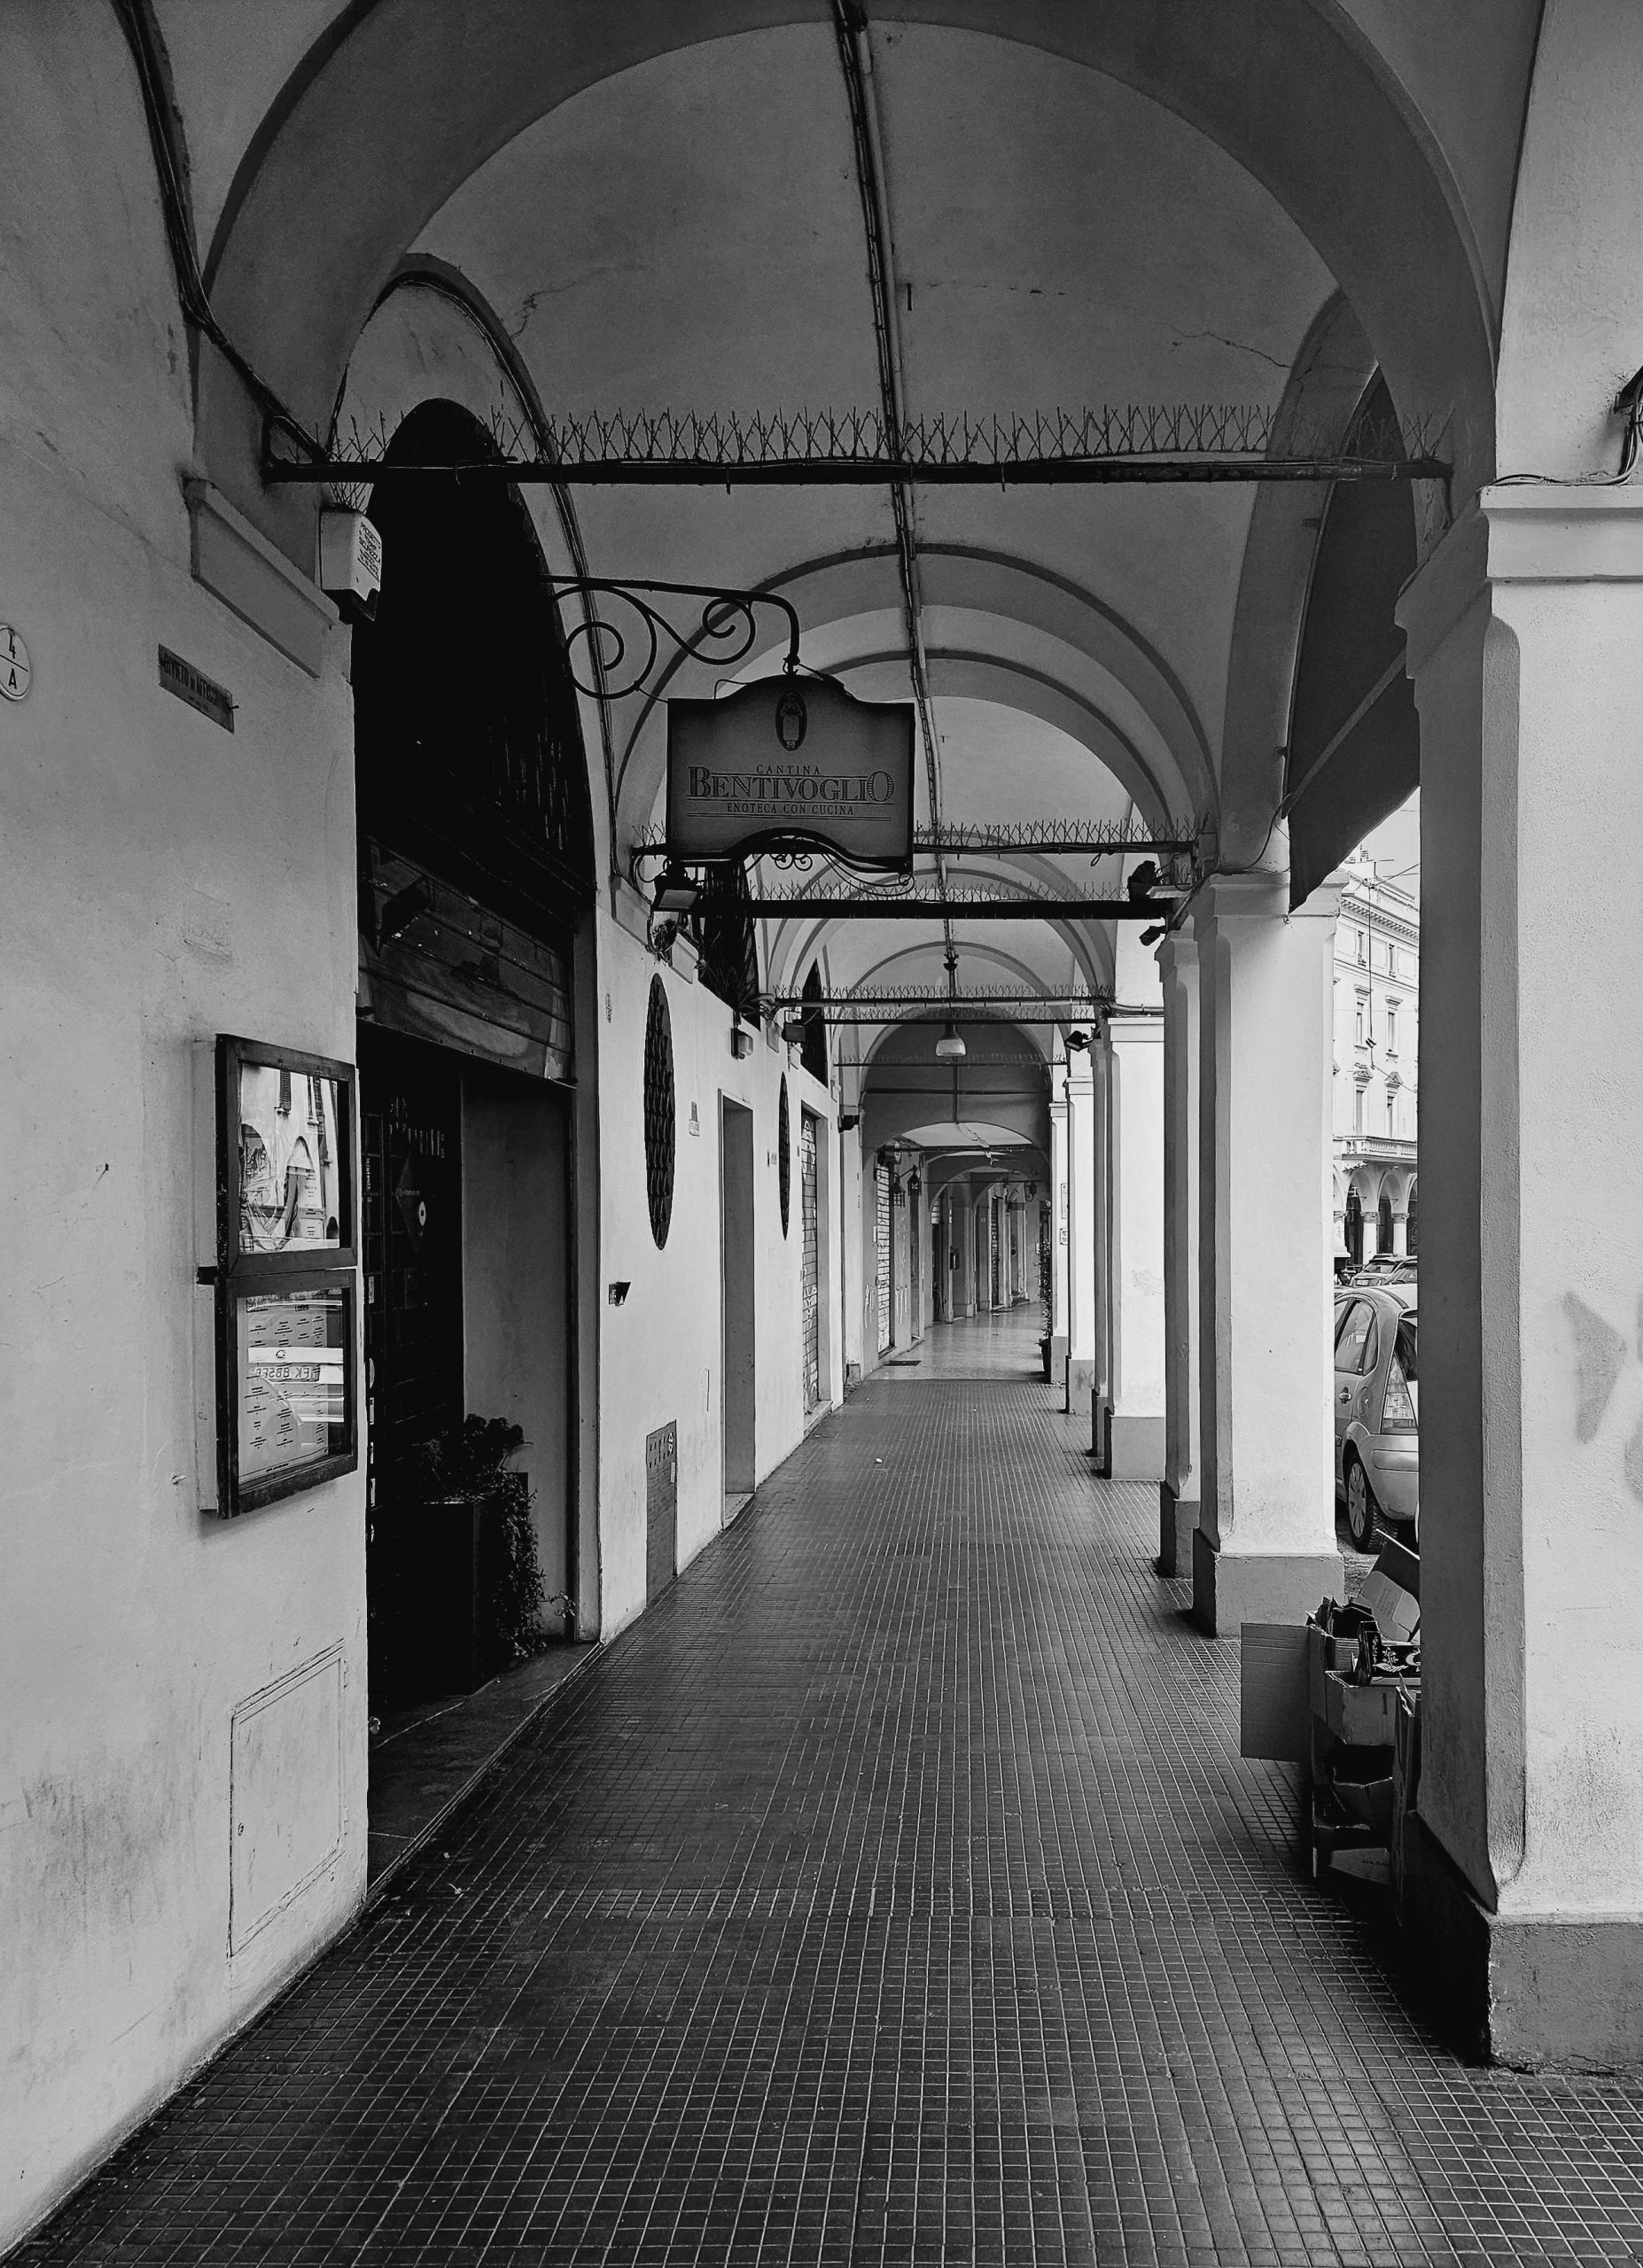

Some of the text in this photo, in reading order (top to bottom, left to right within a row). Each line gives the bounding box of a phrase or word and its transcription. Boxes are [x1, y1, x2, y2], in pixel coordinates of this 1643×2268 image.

[8, 631, 16, 659] 4
[8, 668, 17, 690] A
[756, 765, 821, 775] CANTINA
[687, 765, 895, 803] BENTIVOGLIO
[727, 803, 854, 816] ENOTECA CON CUCINA
